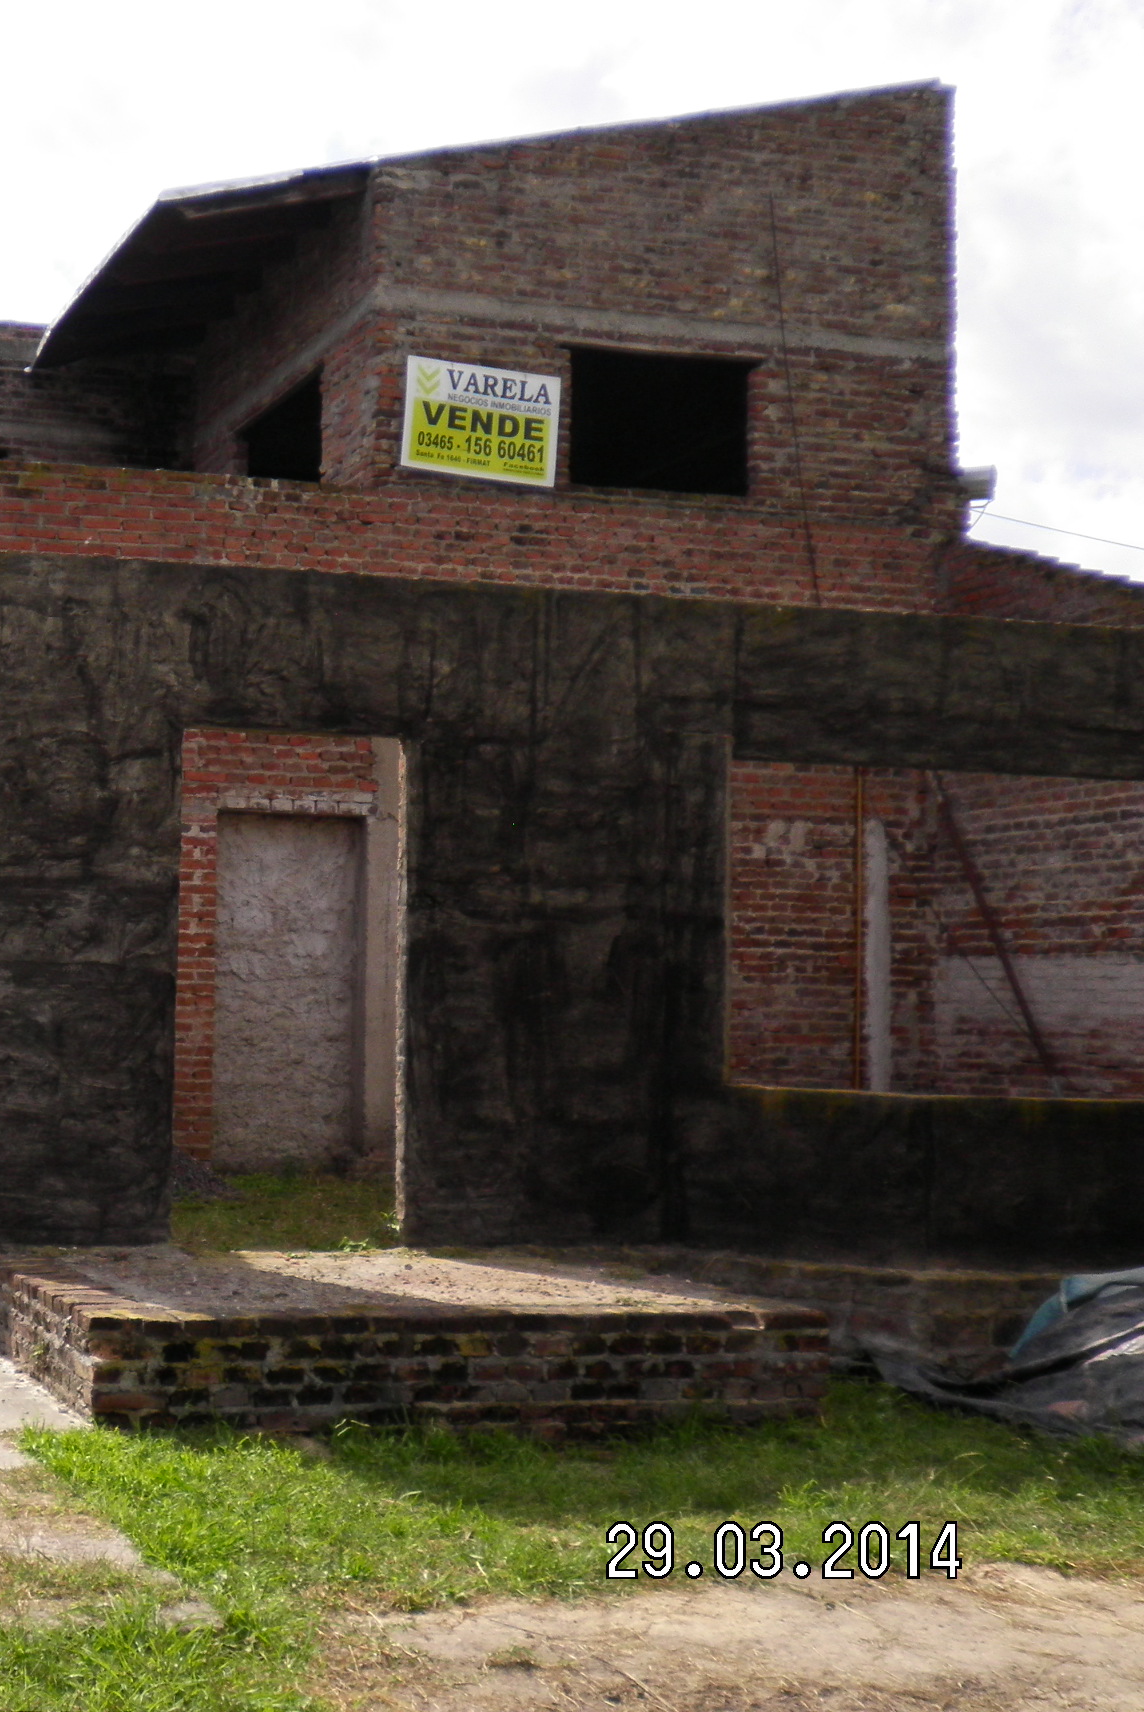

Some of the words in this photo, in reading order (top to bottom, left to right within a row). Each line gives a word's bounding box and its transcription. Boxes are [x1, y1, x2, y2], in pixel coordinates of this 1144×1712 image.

[446, 368, 552, 405] VARELA
[447, 393, 489, 408] NEGOCIOS
[490, 400, 552, 416] INMOBILIARIOS
[422, 401, 546, 442] VENDE
[417, 431, 454, 451] 03465
[465, 435, 492, 457] 156
[497, 439, 545, 464] 60461
[466, 457, 491, 467] FIRMAT
